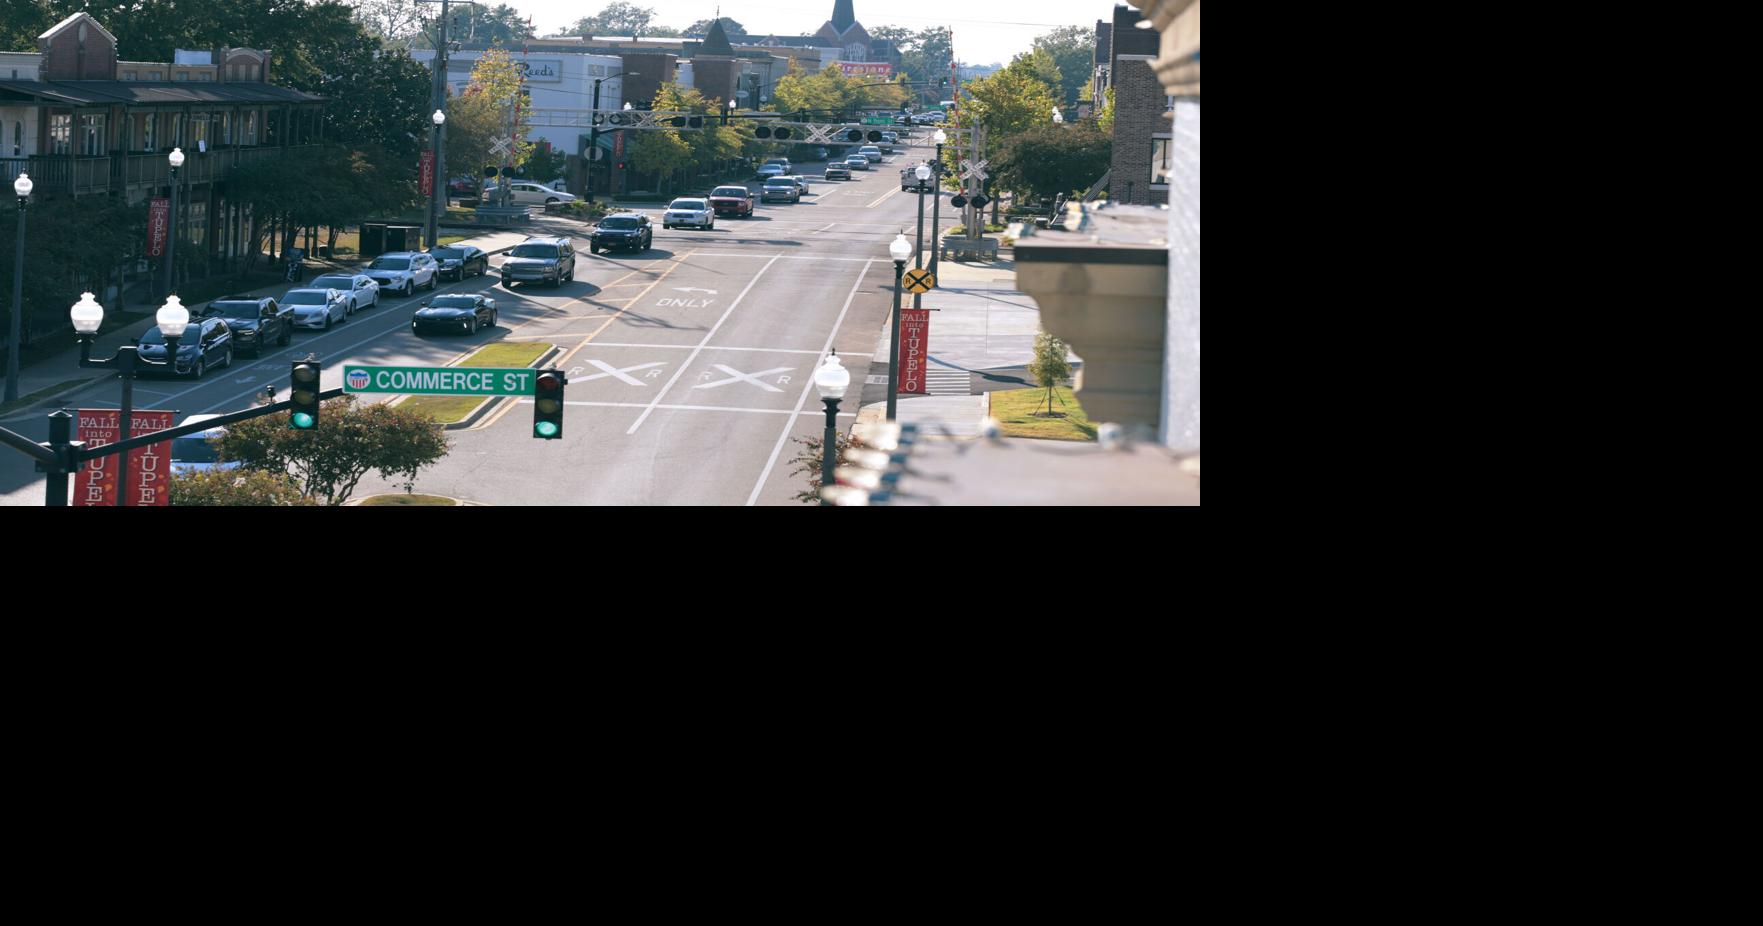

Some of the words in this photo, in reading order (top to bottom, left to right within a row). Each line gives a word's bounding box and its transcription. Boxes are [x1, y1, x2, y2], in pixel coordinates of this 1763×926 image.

[519, 62, 554, 78] Reed's
[152, 211, 163, 256] TUPELO
[905, 277, 912, 285] R
[925, 277, 932, 285] R
[655, 298, 715, 309] ONLY
[901, 313, 929, 321] FALL
[905, 328, 921, 392] TUPELO
[376, 370, 494, 391] COMMERCE
[502, 372, 529, 391] ST
[80, 417, 120, 428] FALL
[131, 418, 172, 429] FALL
[86, 429, 112, 438] into
[85, 438, 107, 506] TUPE
